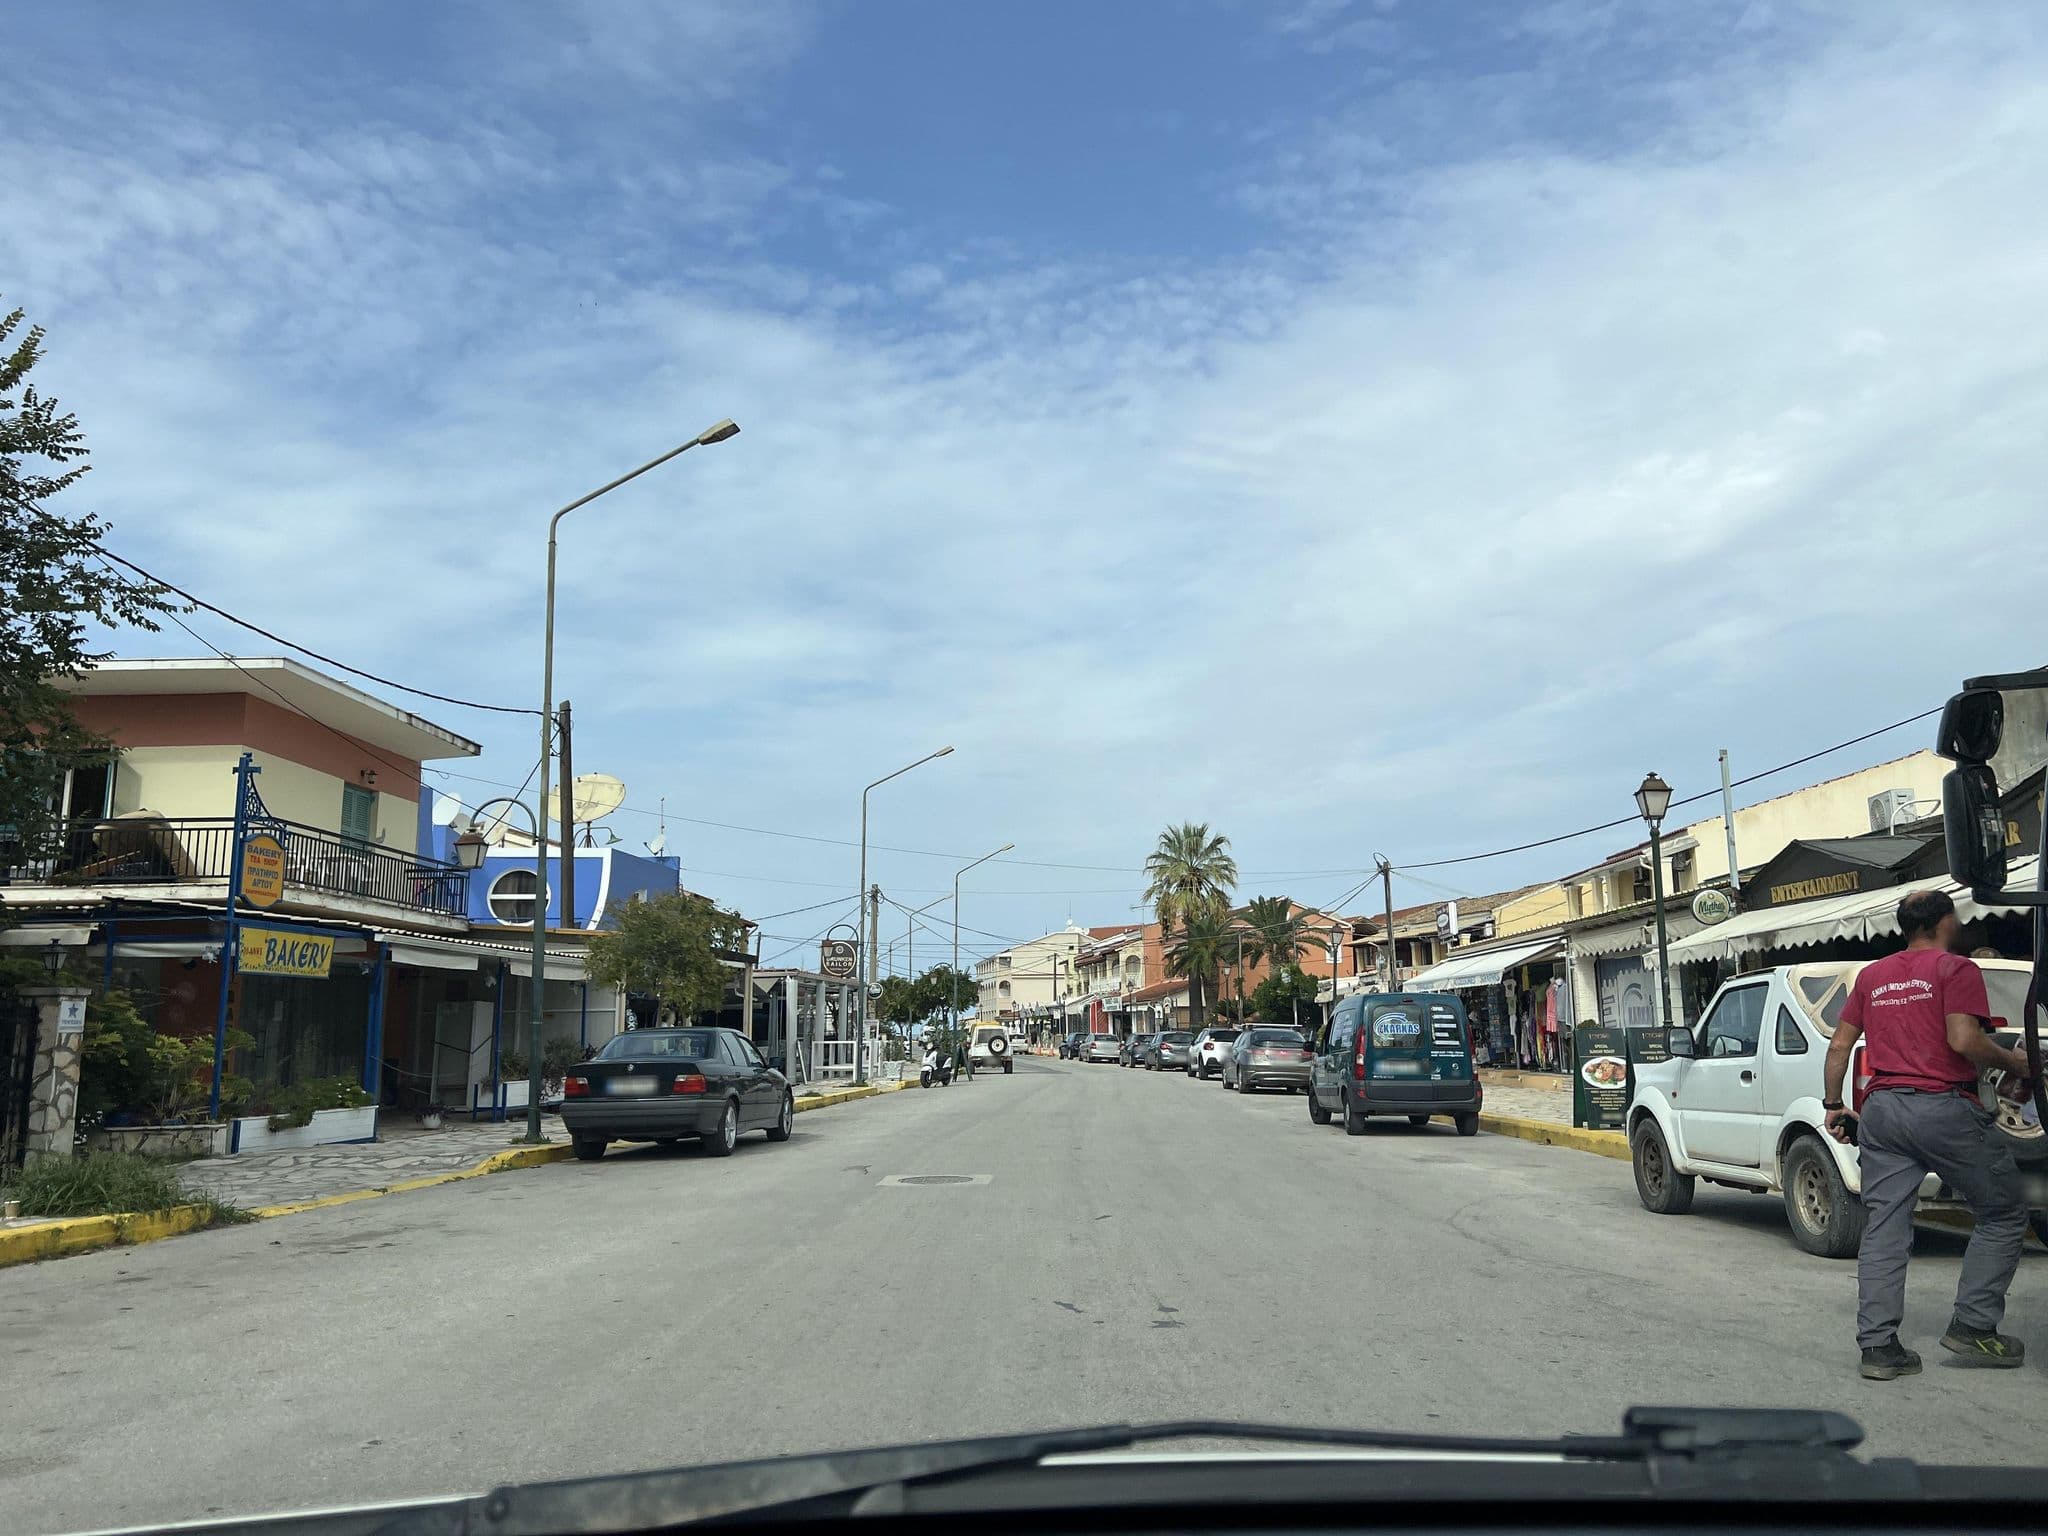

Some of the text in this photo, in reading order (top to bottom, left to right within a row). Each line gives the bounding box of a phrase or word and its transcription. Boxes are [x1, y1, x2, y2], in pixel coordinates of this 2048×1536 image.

[247, 844, 283, 859] BAKERY
[250, 854, 278, 867] TEA SHOP
[252, 878, 273, 889] ΑΡΤΟΥ
[1770, 871, 1860, 904] ENTERTAINMENT
[1698, 900, 1726, 916] Mythos
[265, 937, 331, 969] BAKERY
